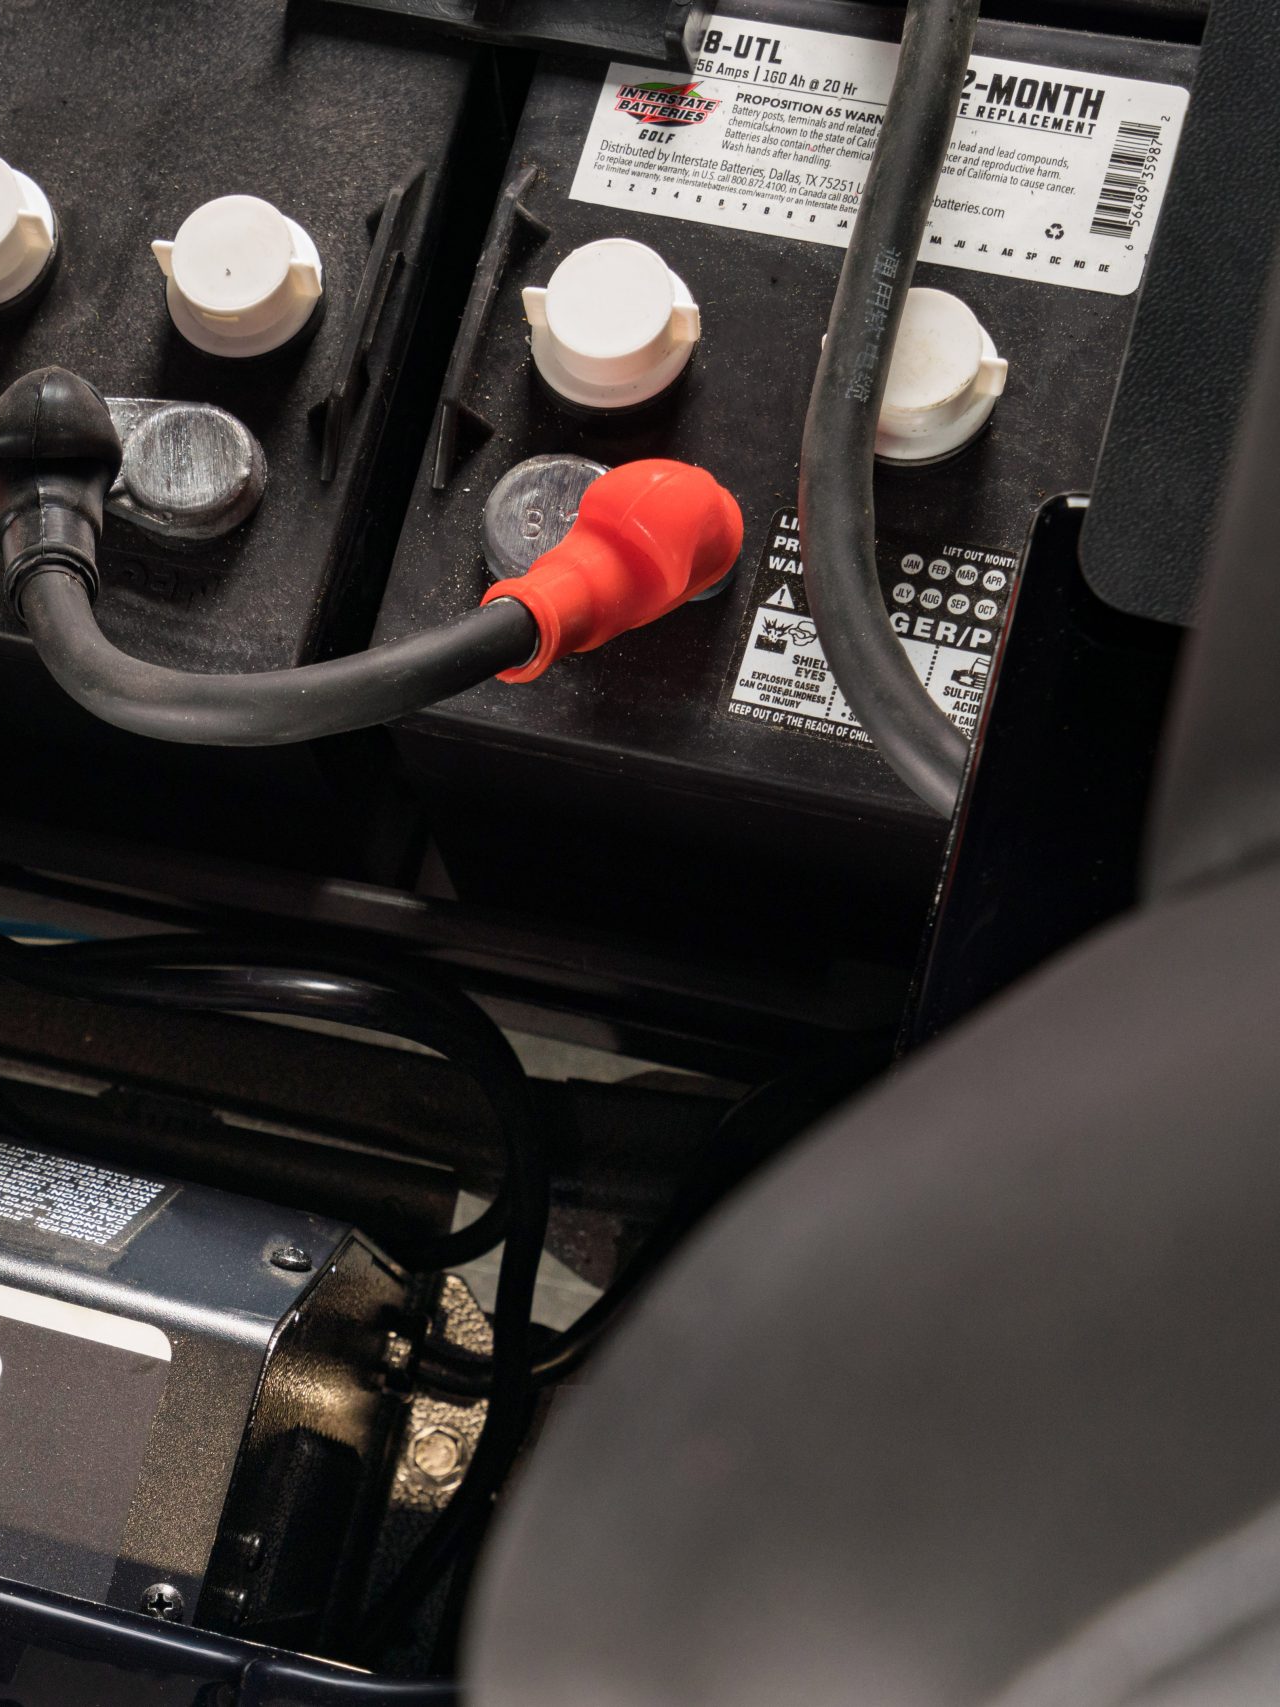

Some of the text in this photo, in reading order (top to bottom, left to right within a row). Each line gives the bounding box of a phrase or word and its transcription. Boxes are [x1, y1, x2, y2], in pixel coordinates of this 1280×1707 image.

[692, 57, 859, 96] 56 Amps 160 Ah @ 20 Hr
[618, 100, 706, 122] BATTERIES
[620, 87, 717, 111] INTERSTATE
[735, 92, 884, 125] PROPOSITION 65 WARN
[974, 105, 1096, 135] REPLACEMENT
[638, 129, 676, 145] GOLF
[730, 104, 1070, 169] Battery posts, terminals and related lead and lead compounds,
[599, 139, 657, 159] Distributed
[655, 148, 671, 163] by
[670, 151, 719, 169] Interstate
[719, 159, 767, 179] Batteries,
[768, 167, 803, 184] Dallas,
[803, 173, 818, 186] TX
[818, 175, 854, 192] 75251
[720, 139, 833, 168] Wash hands after handling.
[595, 152, 606, 161] To
[605, 154, 633, 167] replace
[633, 159, 656, 170] under
[656, 163, 691, 177] warranty,
[797, 186, 827, 199] Canada
[961, 154, 1062, 179] and reproductive harm.
[1129, 138, 1163, 227] 56489 35987
[929, 235, 1109, 272] MA JU JL AG SP OC NO DE
[942, 545, 963, 558] LIFT
[963, 549, 984, 562] OUT
[903, 558, 1002, 586] JAN FEB MAR APR
[895, 587, 994, 615] JLY AUG SEP OCT
[791, 654, 833, 671] SHIEL
[794, 666, 826, 682] EYES
[739, 678, 826, 704] CAN CAUSE BLINDNESS
[750, 671, 820, 693] EXPLOSIVE GASES
[758, 692, 801, 709] OR INJURY
[952, 700, 979, 715] ACID
[47, 1188, 138, 1215] ATTENTION:
[74, 1178, 152, 1202] WARNING:
[45, 1211, 119, 1234] DANGER:
[52, 1201, 128, 1225] CAUTION:
[34, 1221, 107, 1244] DANGER:
